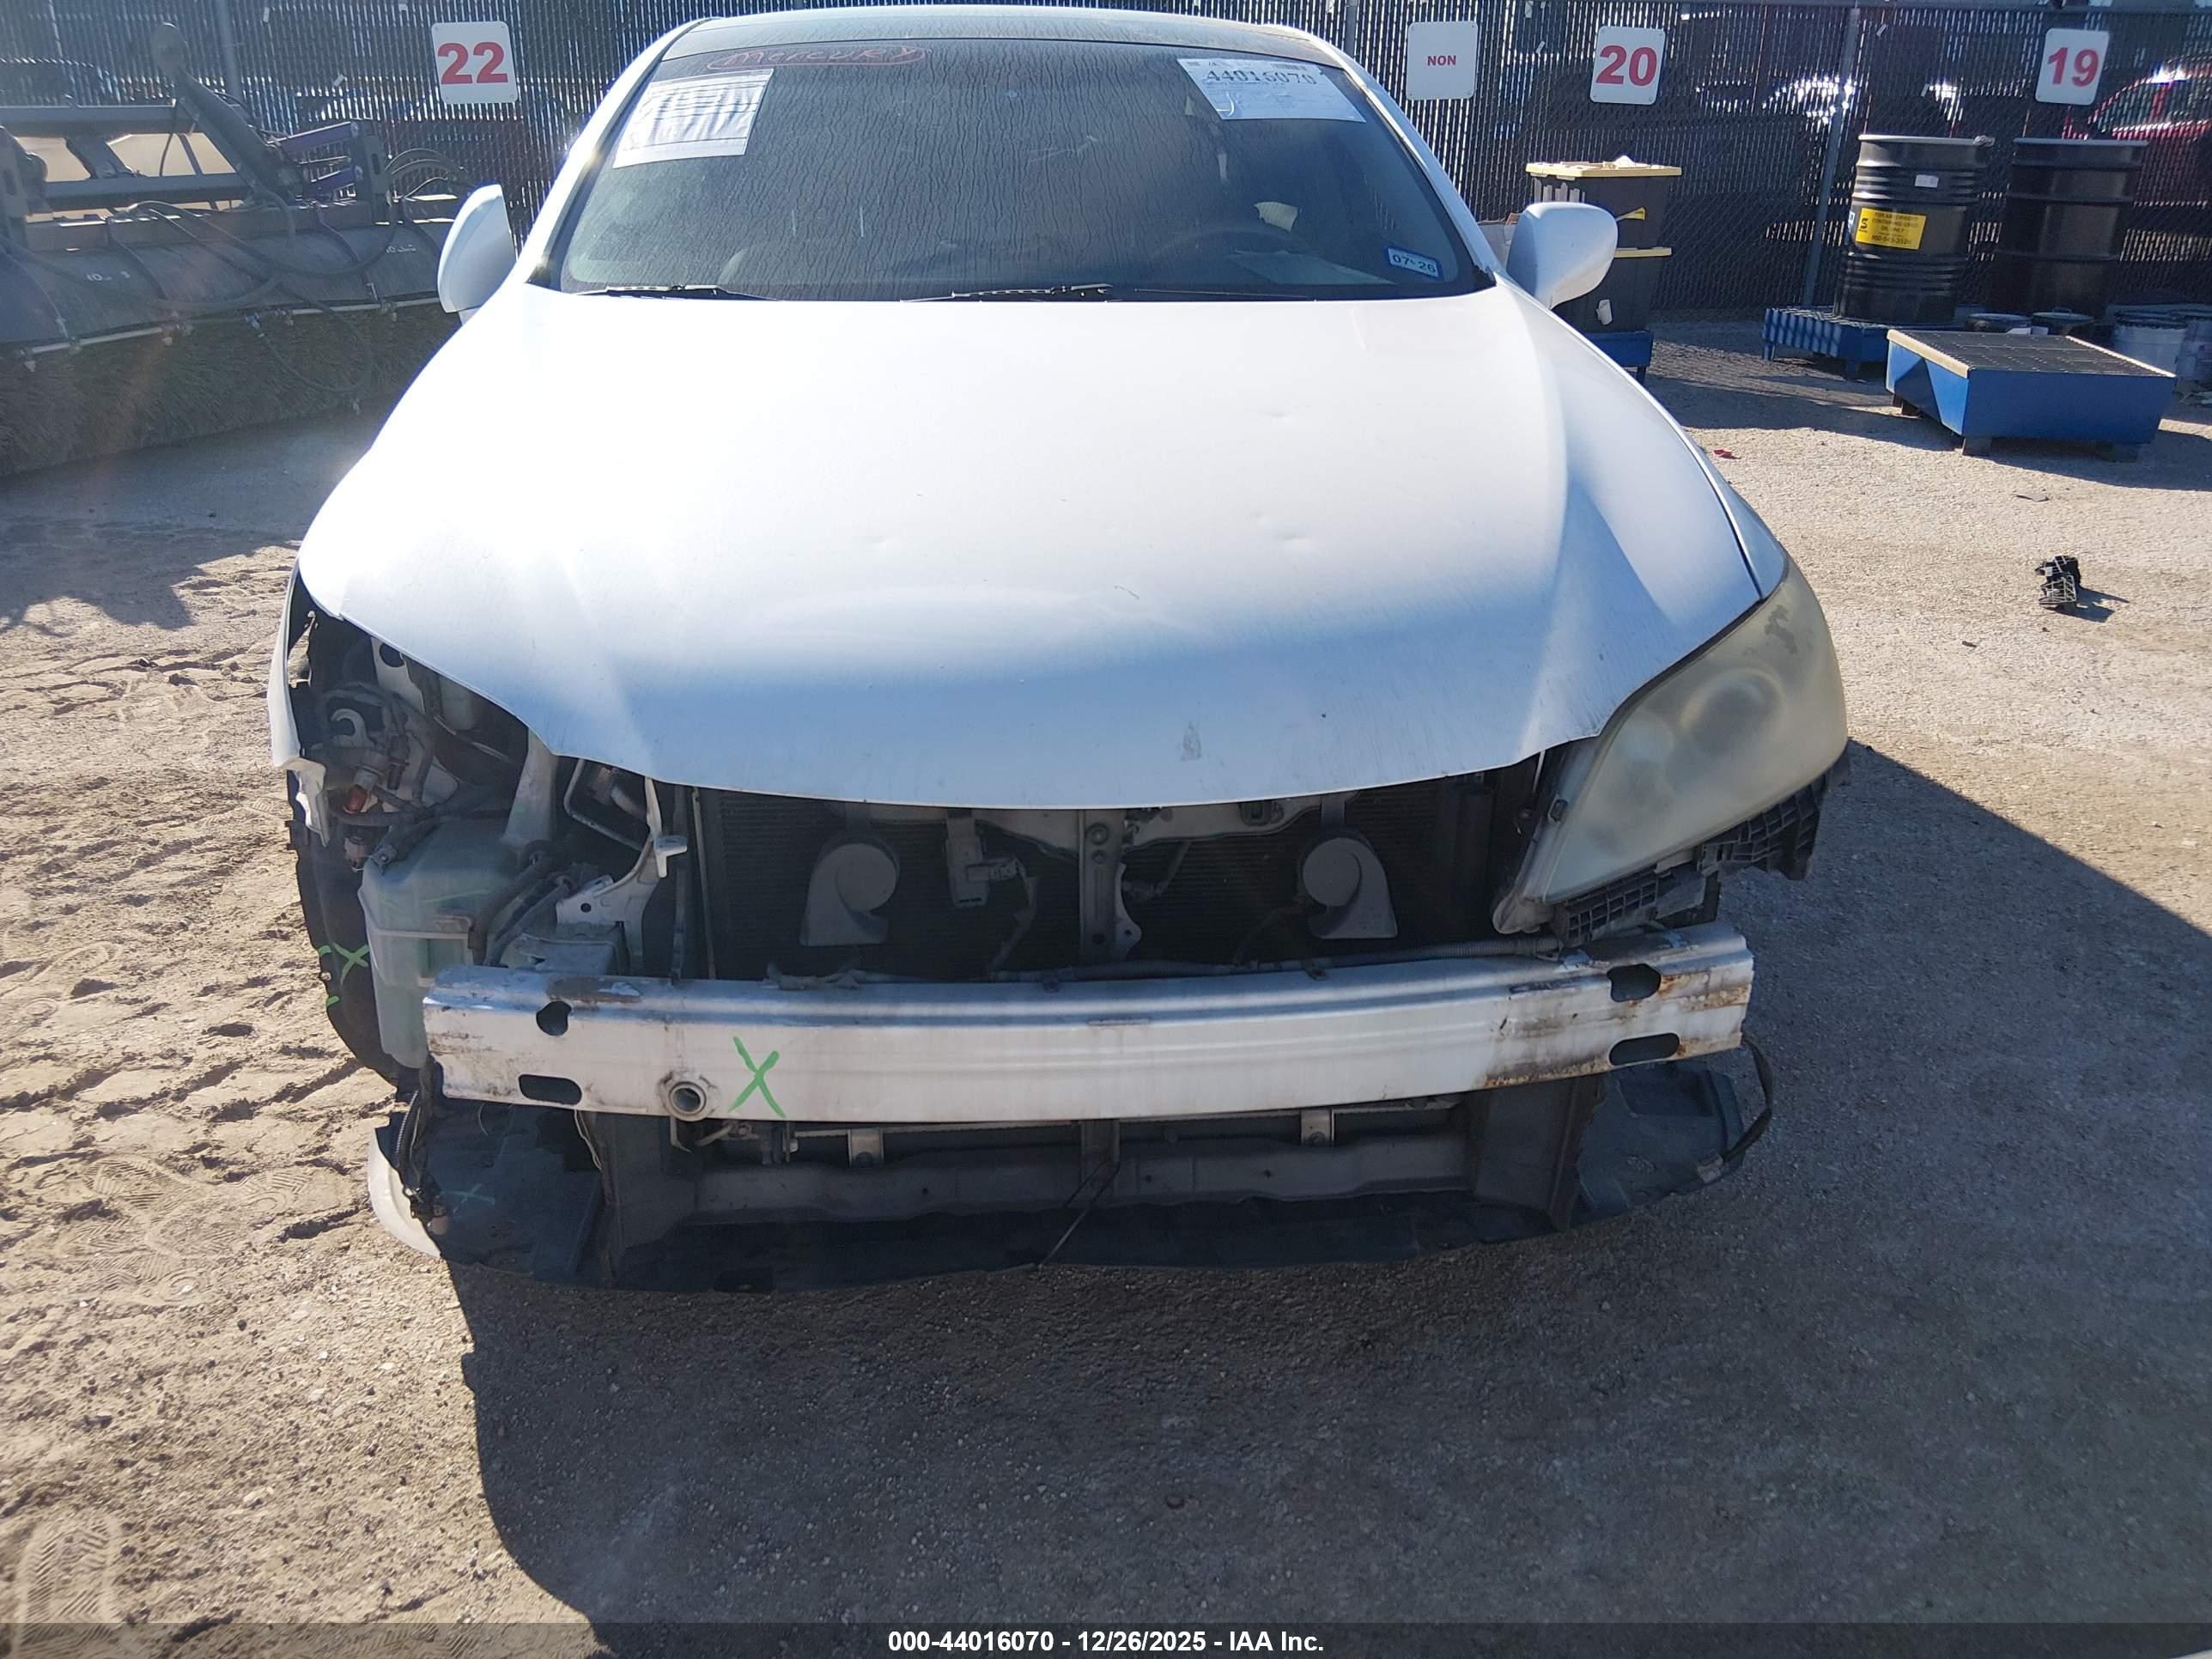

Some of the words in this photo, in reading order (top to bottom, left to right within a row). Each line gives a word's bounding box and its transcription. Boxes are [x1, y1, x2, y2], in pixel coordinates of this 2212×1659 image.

[437, 41, 508, 85] 22
[1426, 55, 1457, 66] NON
[1595, 45, 1657, 87] 20
[2047, 46, 2100, 88] 19
